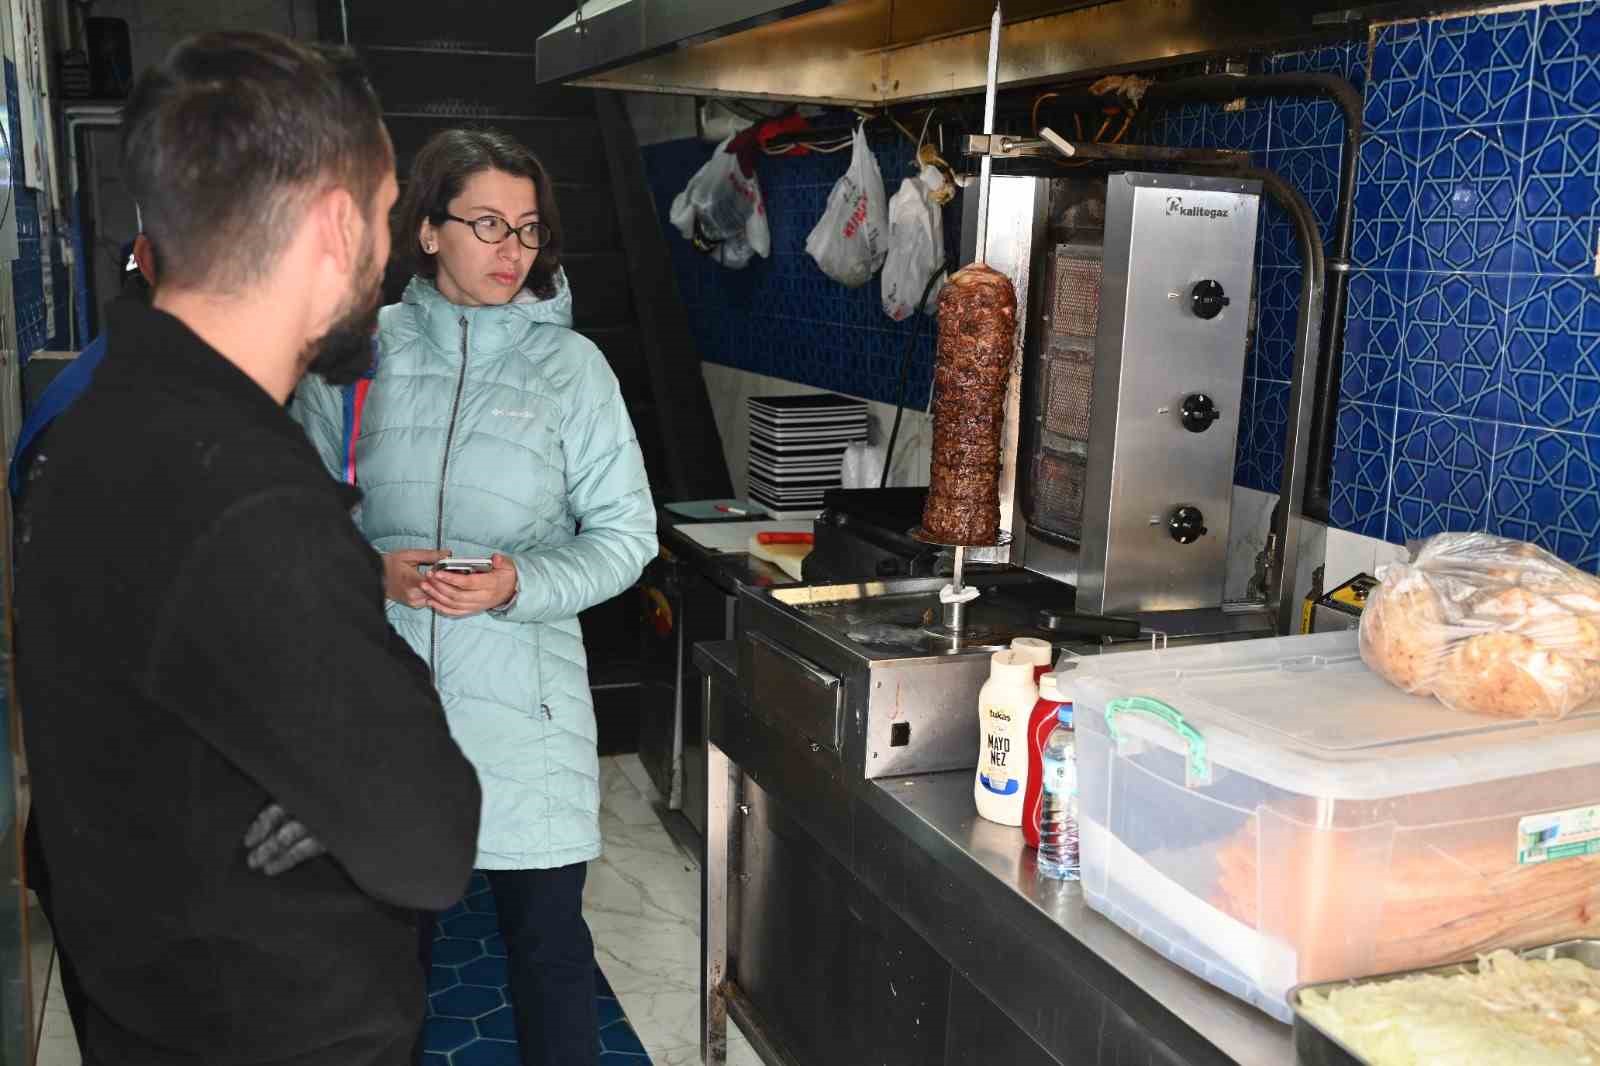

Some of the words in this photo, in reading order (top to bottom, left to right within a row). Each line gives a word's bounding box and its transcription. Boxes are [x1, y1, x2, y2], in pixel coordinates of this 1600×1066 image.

[1180, 206, 1229, 219] kalitegaz
[987, 733, 1010, 752] MAYO
[990, 750, 1006, 767] NEZ
